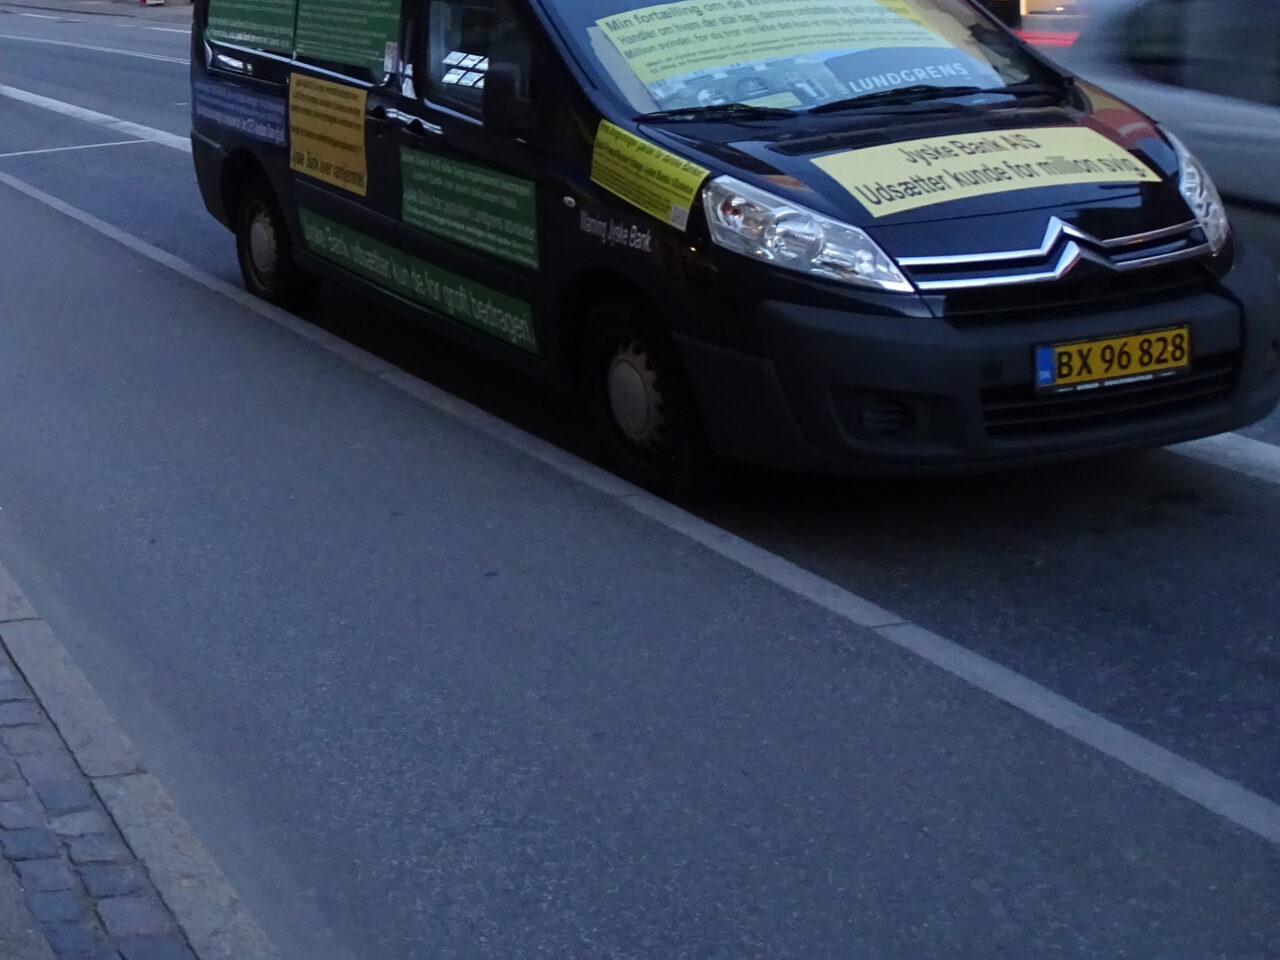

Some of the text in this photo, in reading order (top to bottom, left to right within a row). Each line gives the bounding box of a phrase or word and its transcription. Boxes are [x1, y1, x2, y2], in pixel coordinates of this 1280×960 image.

[604, 19, 635, 32] Min
[633, 5, 704, 24] fortælling
[703, 2, 727, 12] om
[617, 29, 656, 45] Handler
[848, 62, 969, 93] LUNDGRENS
[897, 133, 1042, 167] Jyske Bank A/S
[854, 173, 953, 206] Udsætter
[942, 162, 1013, 188] kunde
[1001, 159, 1042, 180] for
[1035, 155, 1105, 176] million
[629, 224, 653, 253] Bank
[1056, 333, 1186, 379] BX 96 828
